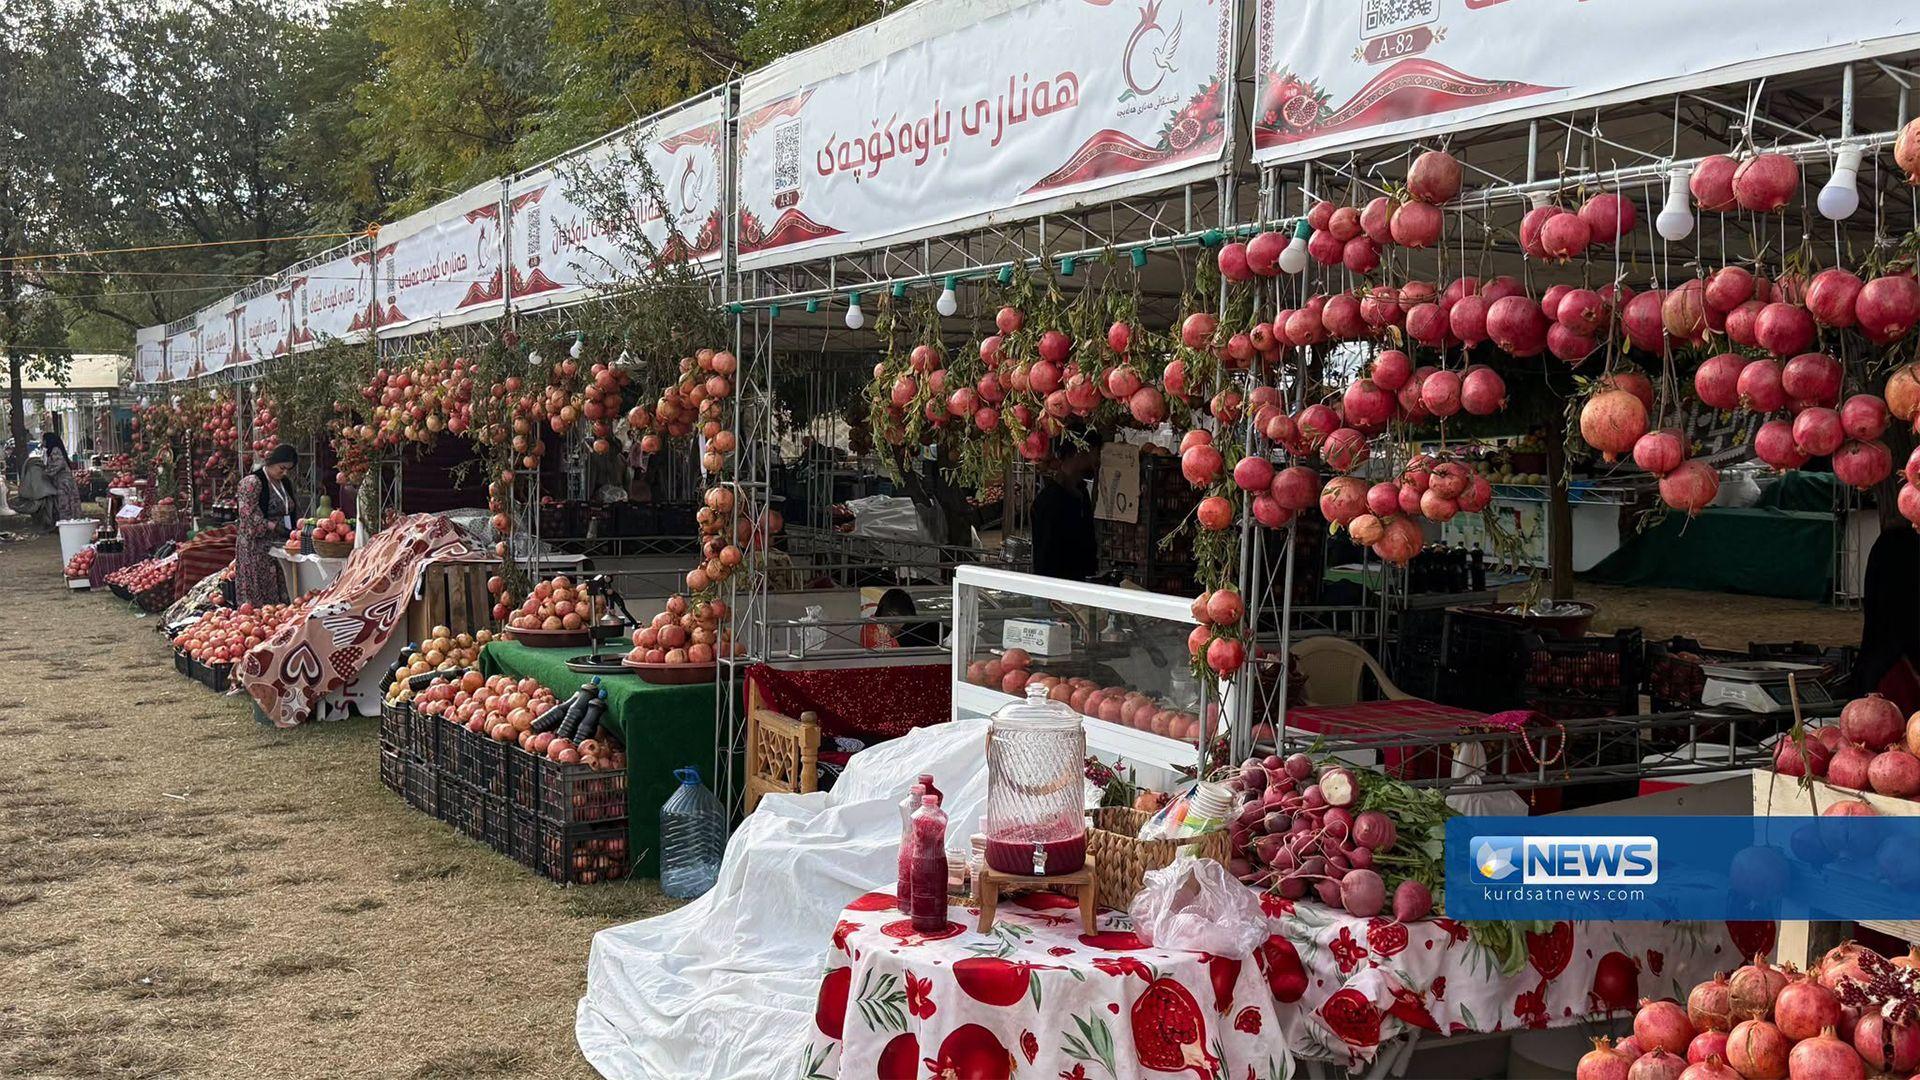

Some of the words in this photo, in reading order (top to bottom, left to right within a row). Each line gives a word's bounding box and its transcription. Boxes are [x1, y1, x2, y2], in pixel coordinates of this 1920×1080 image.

[1377, 33, 1413, 59] A-82
[960, 70, 1080, 148] هەناری
[816, 97, 951, 184] باوەکۆچەک
[442, 251, 468, 282] هەناری
